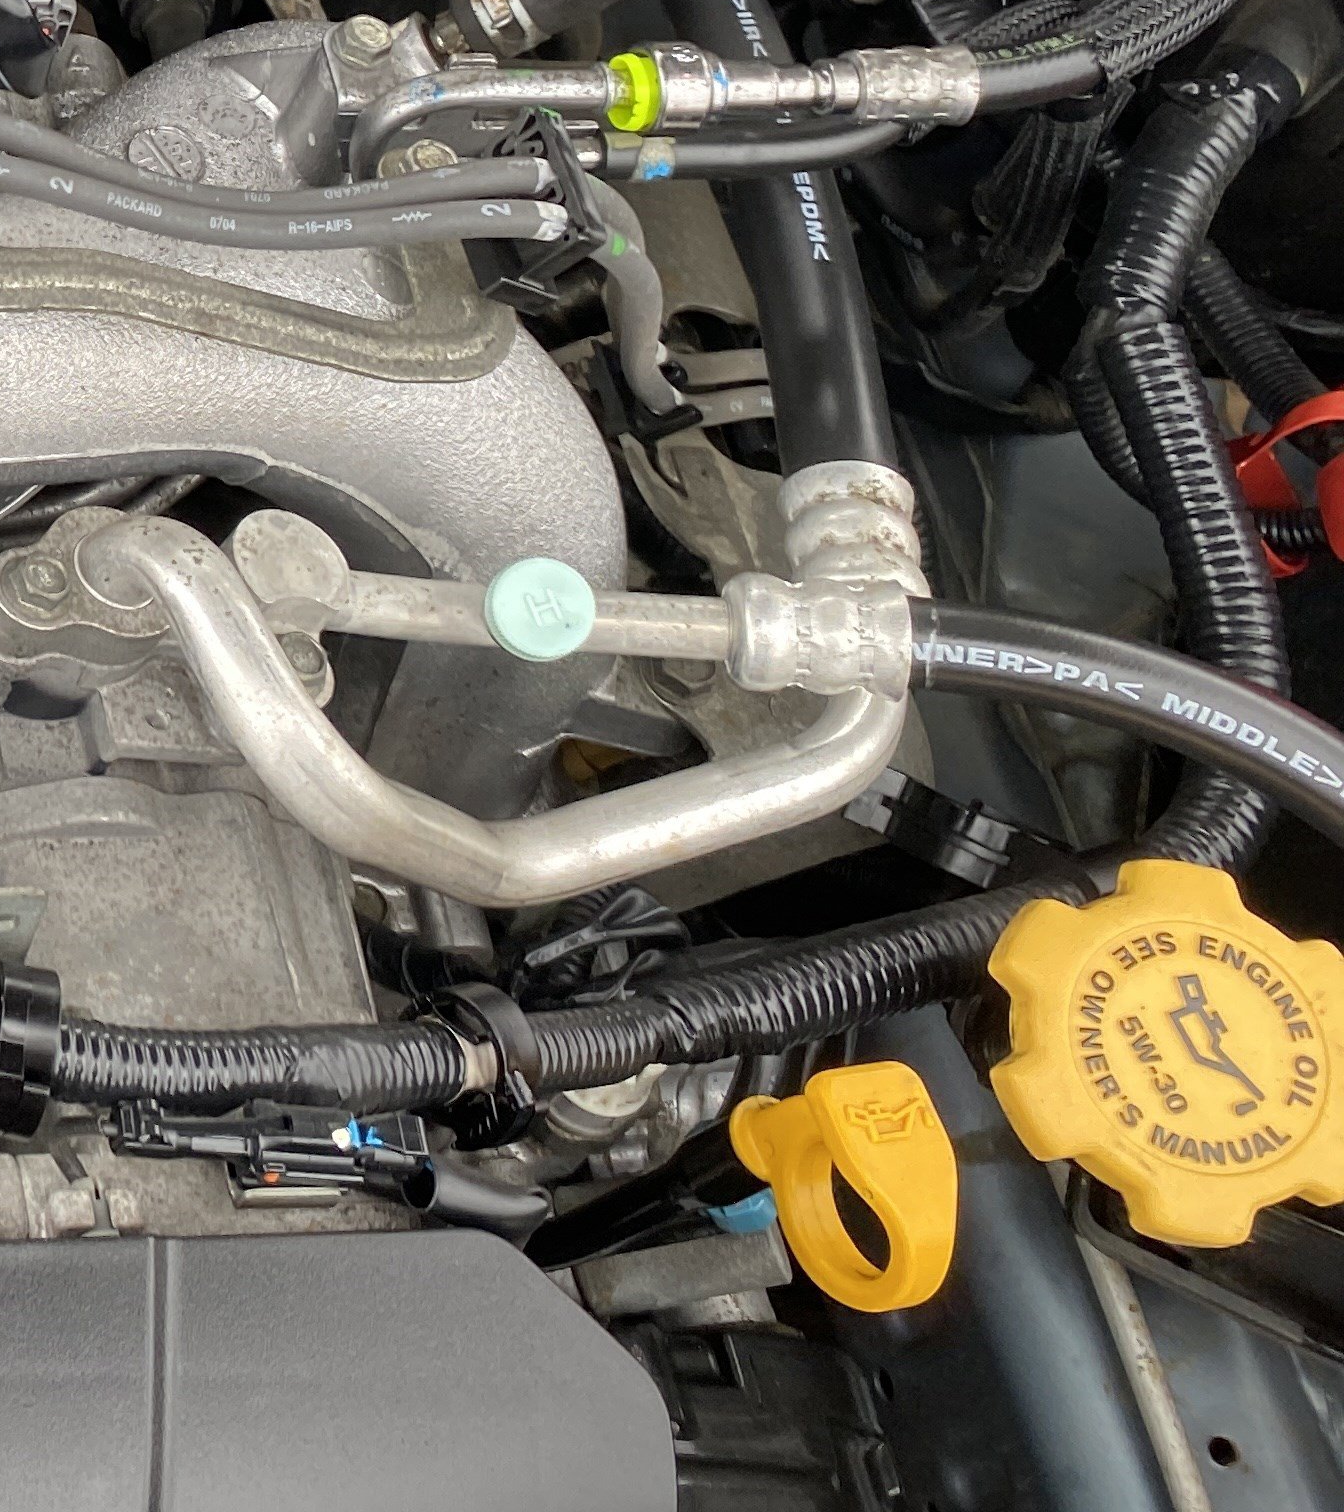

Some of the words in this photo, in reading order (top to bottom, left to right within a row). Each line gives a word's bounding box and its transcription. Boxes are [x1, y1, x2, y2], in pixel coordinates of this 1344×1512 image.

[107, 192, 162, 218] PACKARD
[210, 216, 236, 231] 0704
[792, 171, 831, 262] EPDM<
[912, 641, 1145, 701] NNER>PA<
[1112, 931, 1177, 971] SEE
[1079, 970, 1144, 1129] OWNER'S
[1199, 935, 1315, 1042] ENGINE
[1286, 1055, 1319, 1108] OIL
[1119, 1015, 1188, 1115] 5W-30
[1150, 1125, 1292, 1166] MANUAL
